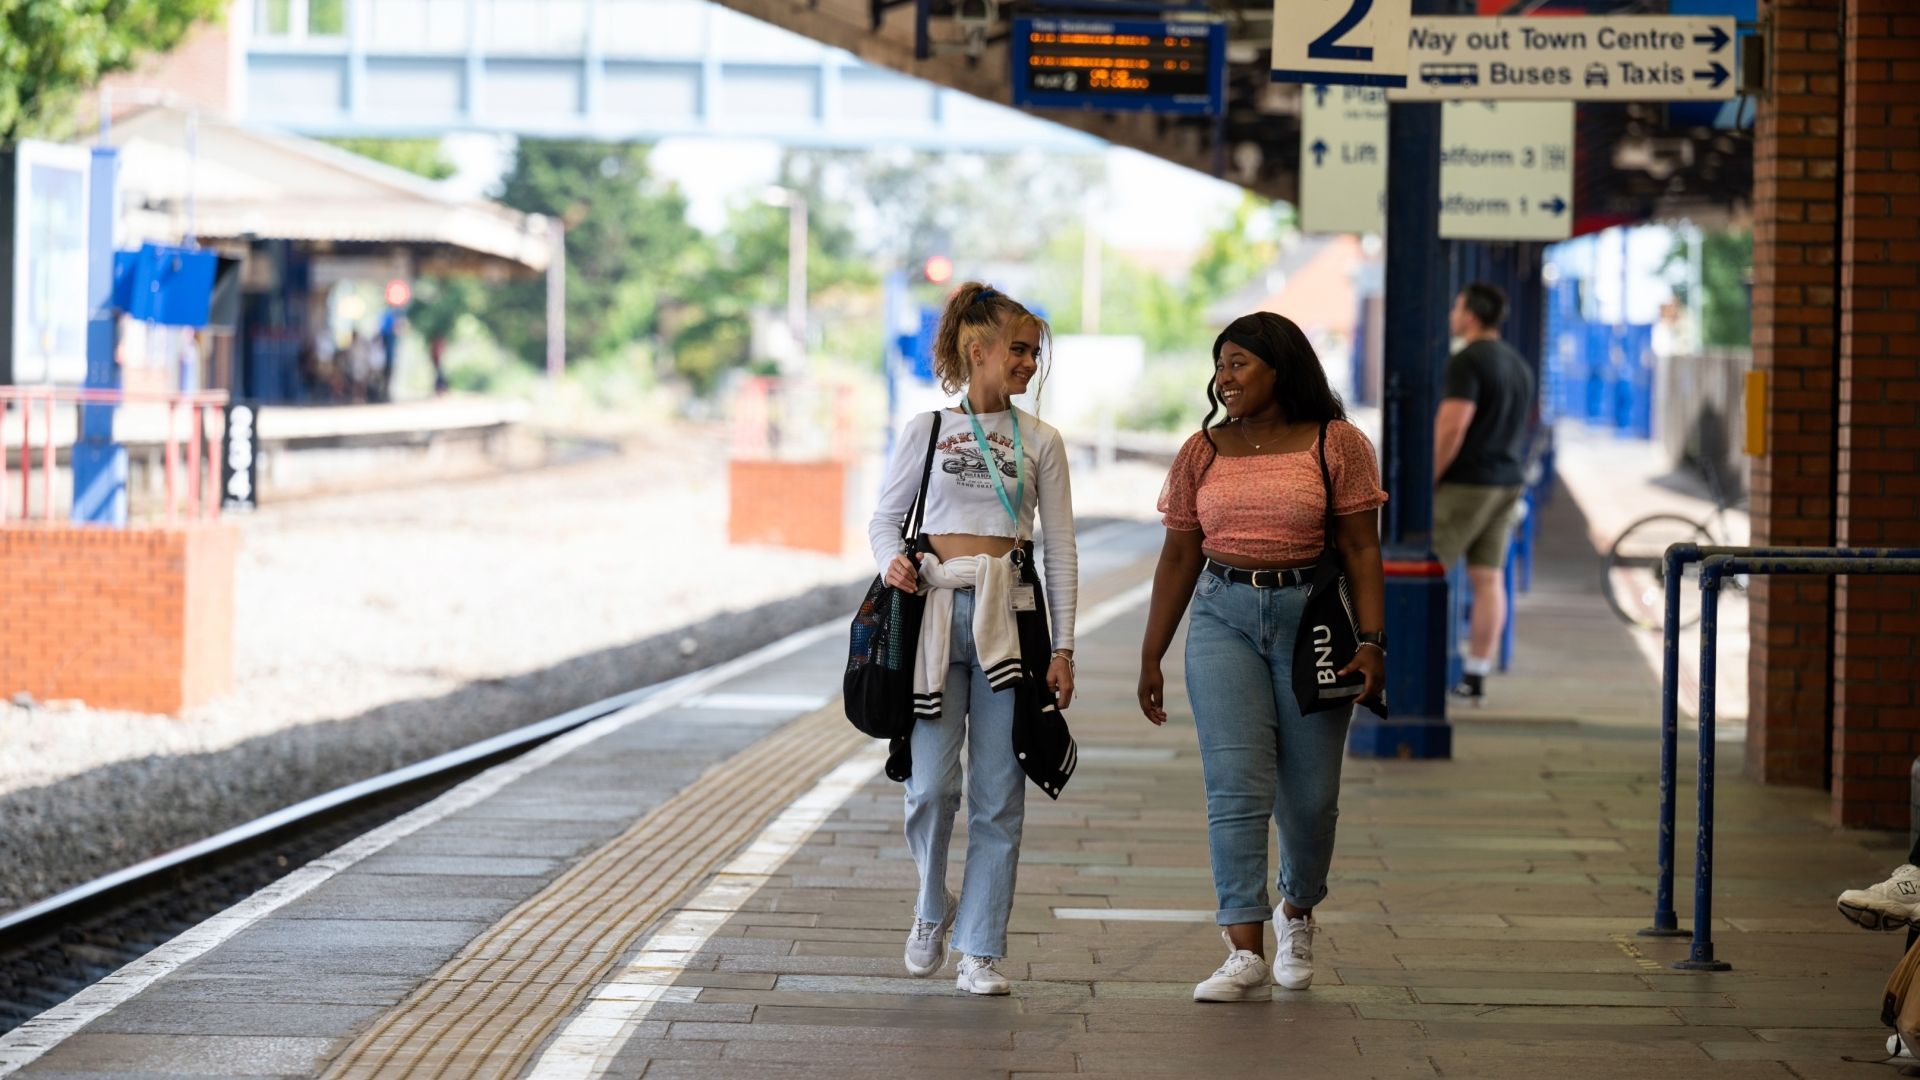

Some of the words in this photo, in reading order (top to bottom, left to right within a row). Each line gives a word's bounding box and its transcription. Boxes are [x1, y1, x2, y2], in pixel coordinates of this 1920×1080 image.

[1307, 0, 1375, 61] 2
[1467, 30, 1509, 49] out
[1520, 28, 1587, 49] Town
[1597, 27, 1684, 50] Centre
[1490, 62, 1571, 84] Buses
[1618, 61, 1684, 84] Taxis
[1341, 143, 1377, 164] Lift
[1312, 624, 1336, 684] BNU
